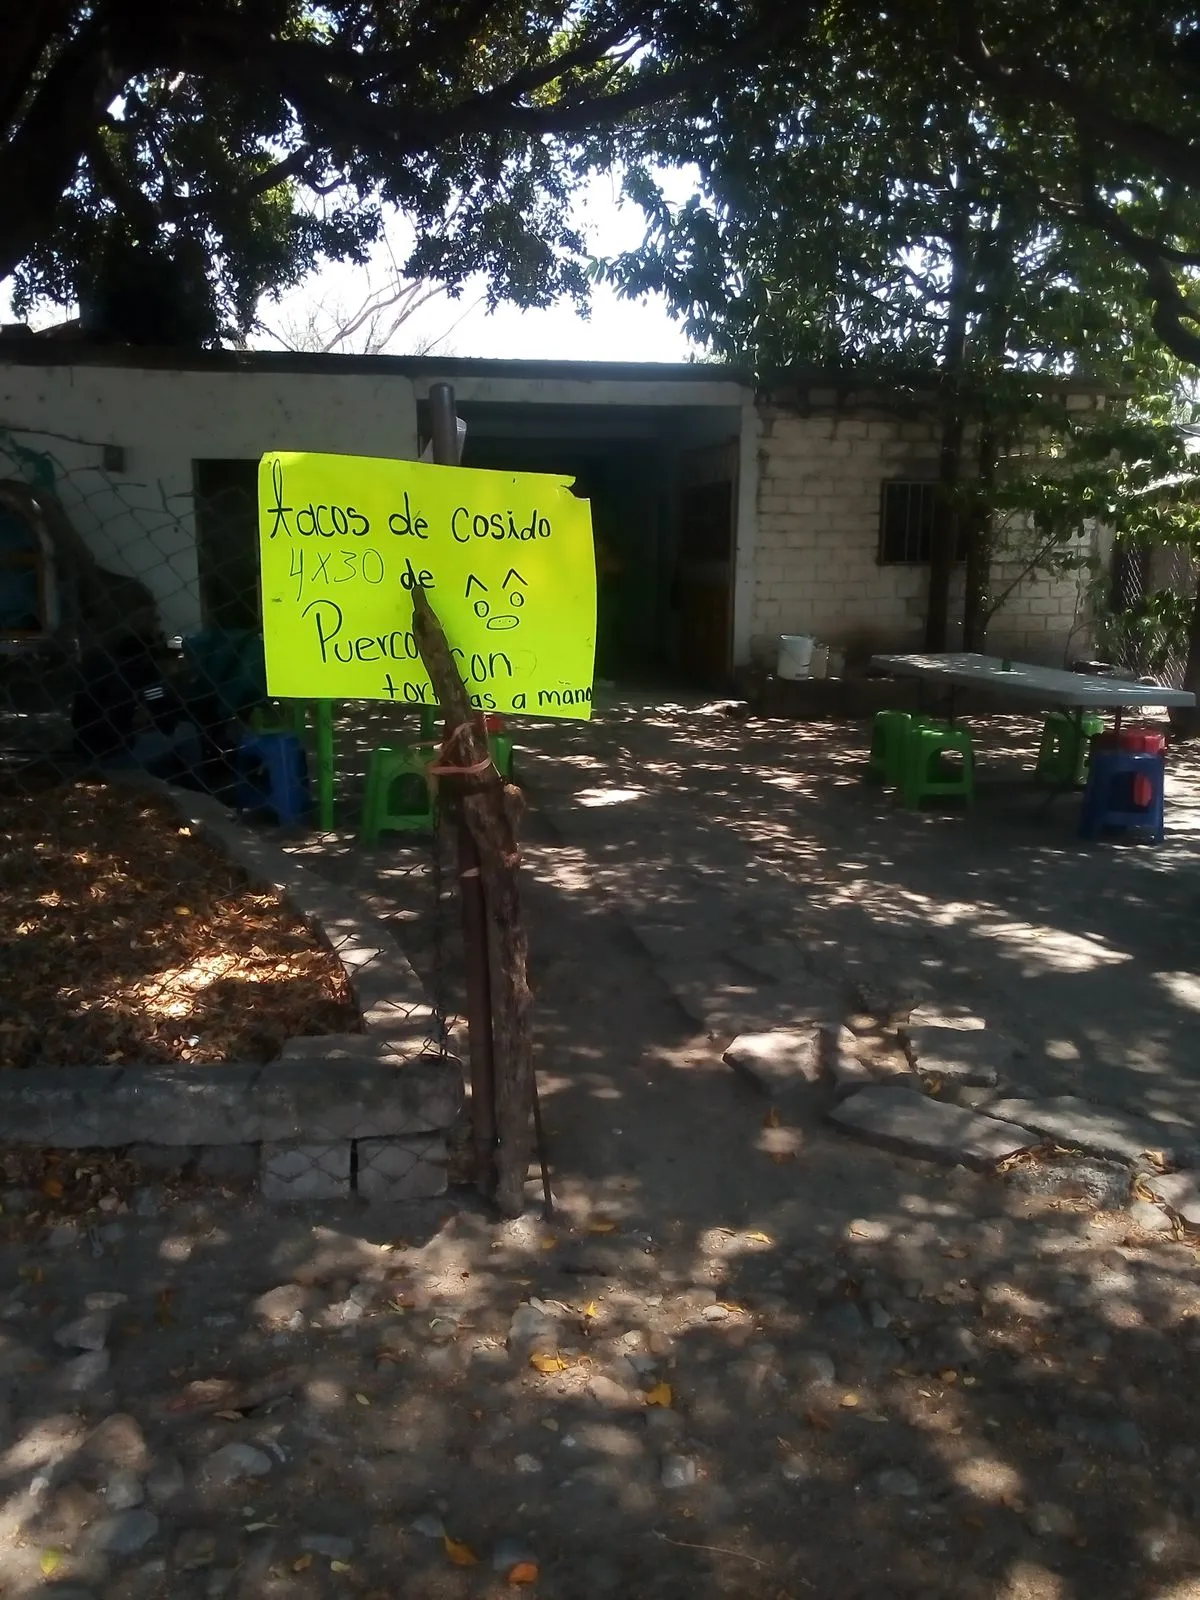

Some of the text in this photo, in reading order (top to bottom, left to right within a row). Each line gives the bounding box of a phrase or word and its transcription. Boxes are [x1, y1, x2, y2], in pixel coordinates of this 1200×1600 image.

[389, 491, 429, 539] de
[400, 558, 435, 589] de
[302, 599, 512, 683] Puerco con
[511, 693, 526, 709] a
